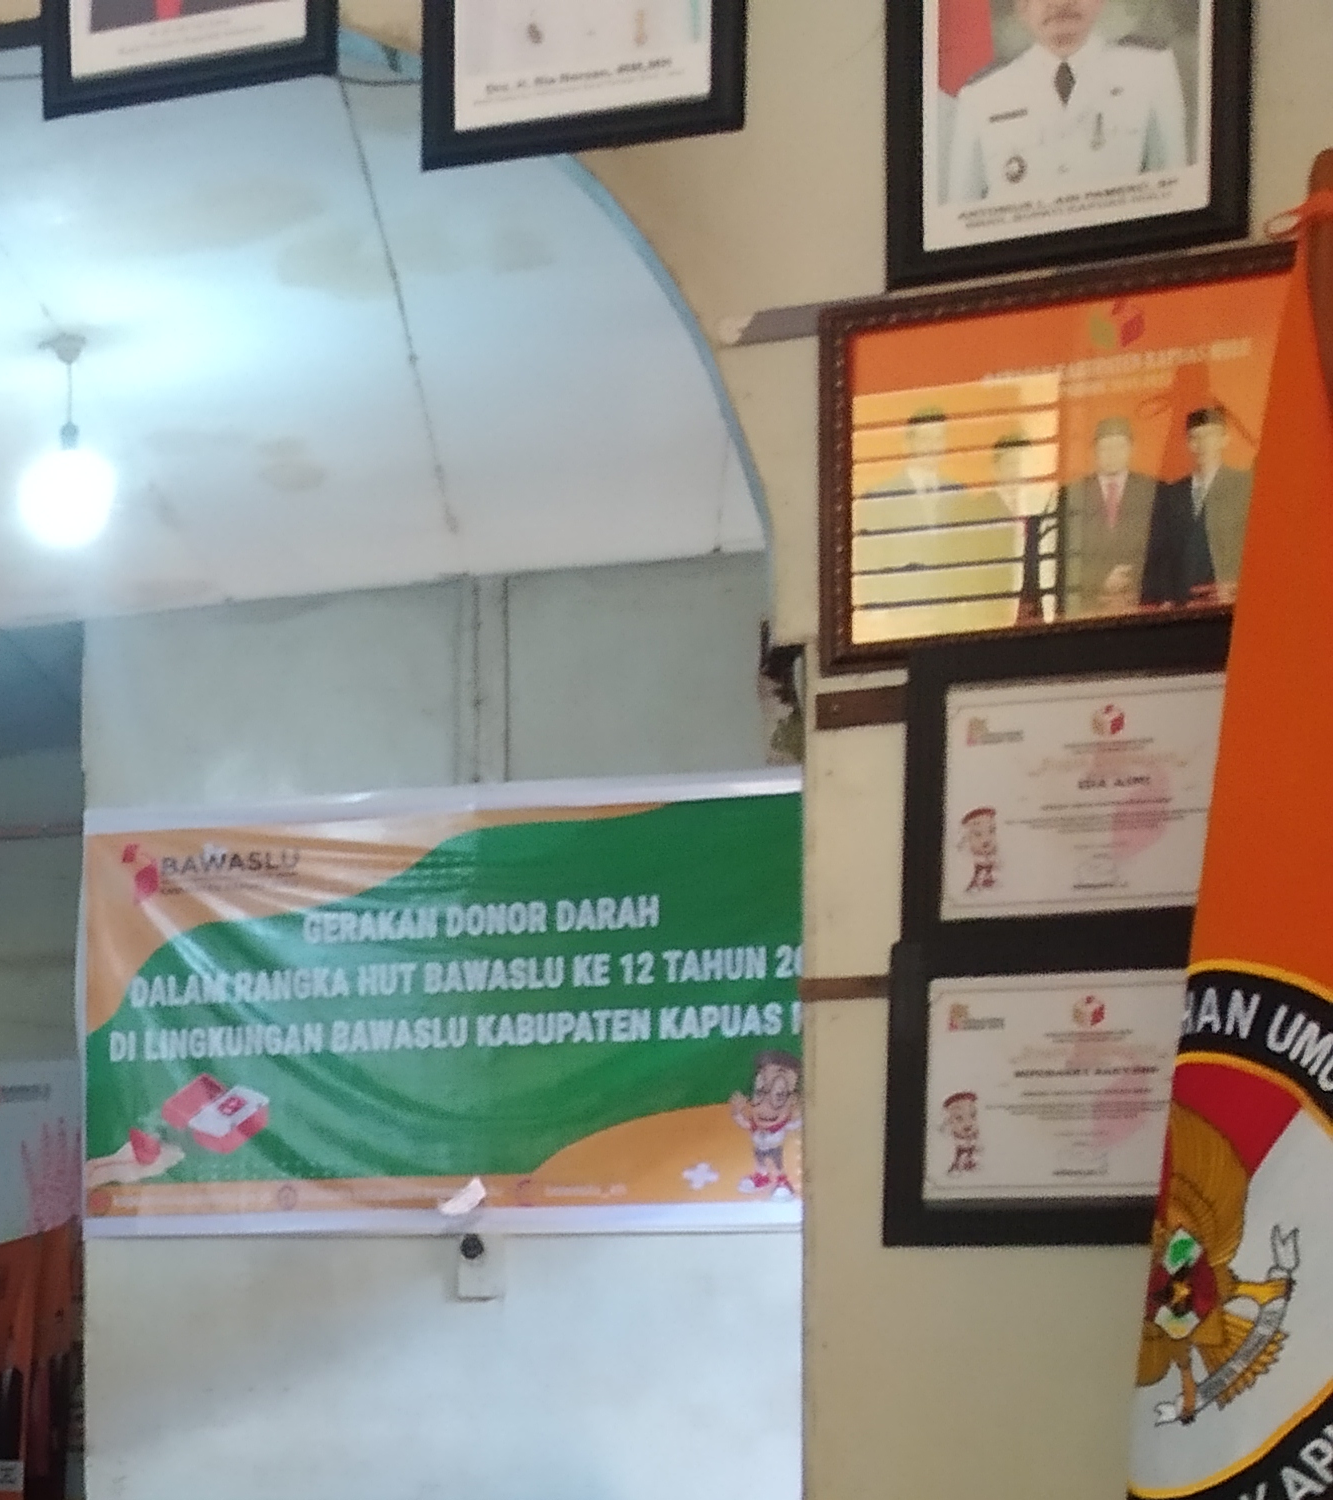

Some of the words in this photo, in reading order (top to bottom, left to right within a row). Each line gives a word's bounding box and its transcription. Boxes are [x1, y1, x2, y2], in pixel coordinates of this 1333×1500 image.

[161, 850, 301, 876] BAWASLU
[304, 905, 437, 945] GERAKAN
[445, 900, 548, 938] DONOR
[556, 894, 661, 933] DARAH
[131, 968, 230, 1009] DALAM
[234, 966, 351, 1003] RANGKA
[357, 962, 416, 996] HUT
[424, 955, 565, 995] BAWASLU
[572, 952, 611, 988] KE
[620, 950, 656, 986] 12
[662, 945, 768, 985] TAHUN
[109, 1030, 136, 1063] DI
[144, 1020, 324, 1062] LINGKUNGAN
[332, 1016, 469, 1053] BAWASLU
[476, 1007, 652, 1049] KABUPATEN
[658, 1002, 783, 1041] KAPUAS
